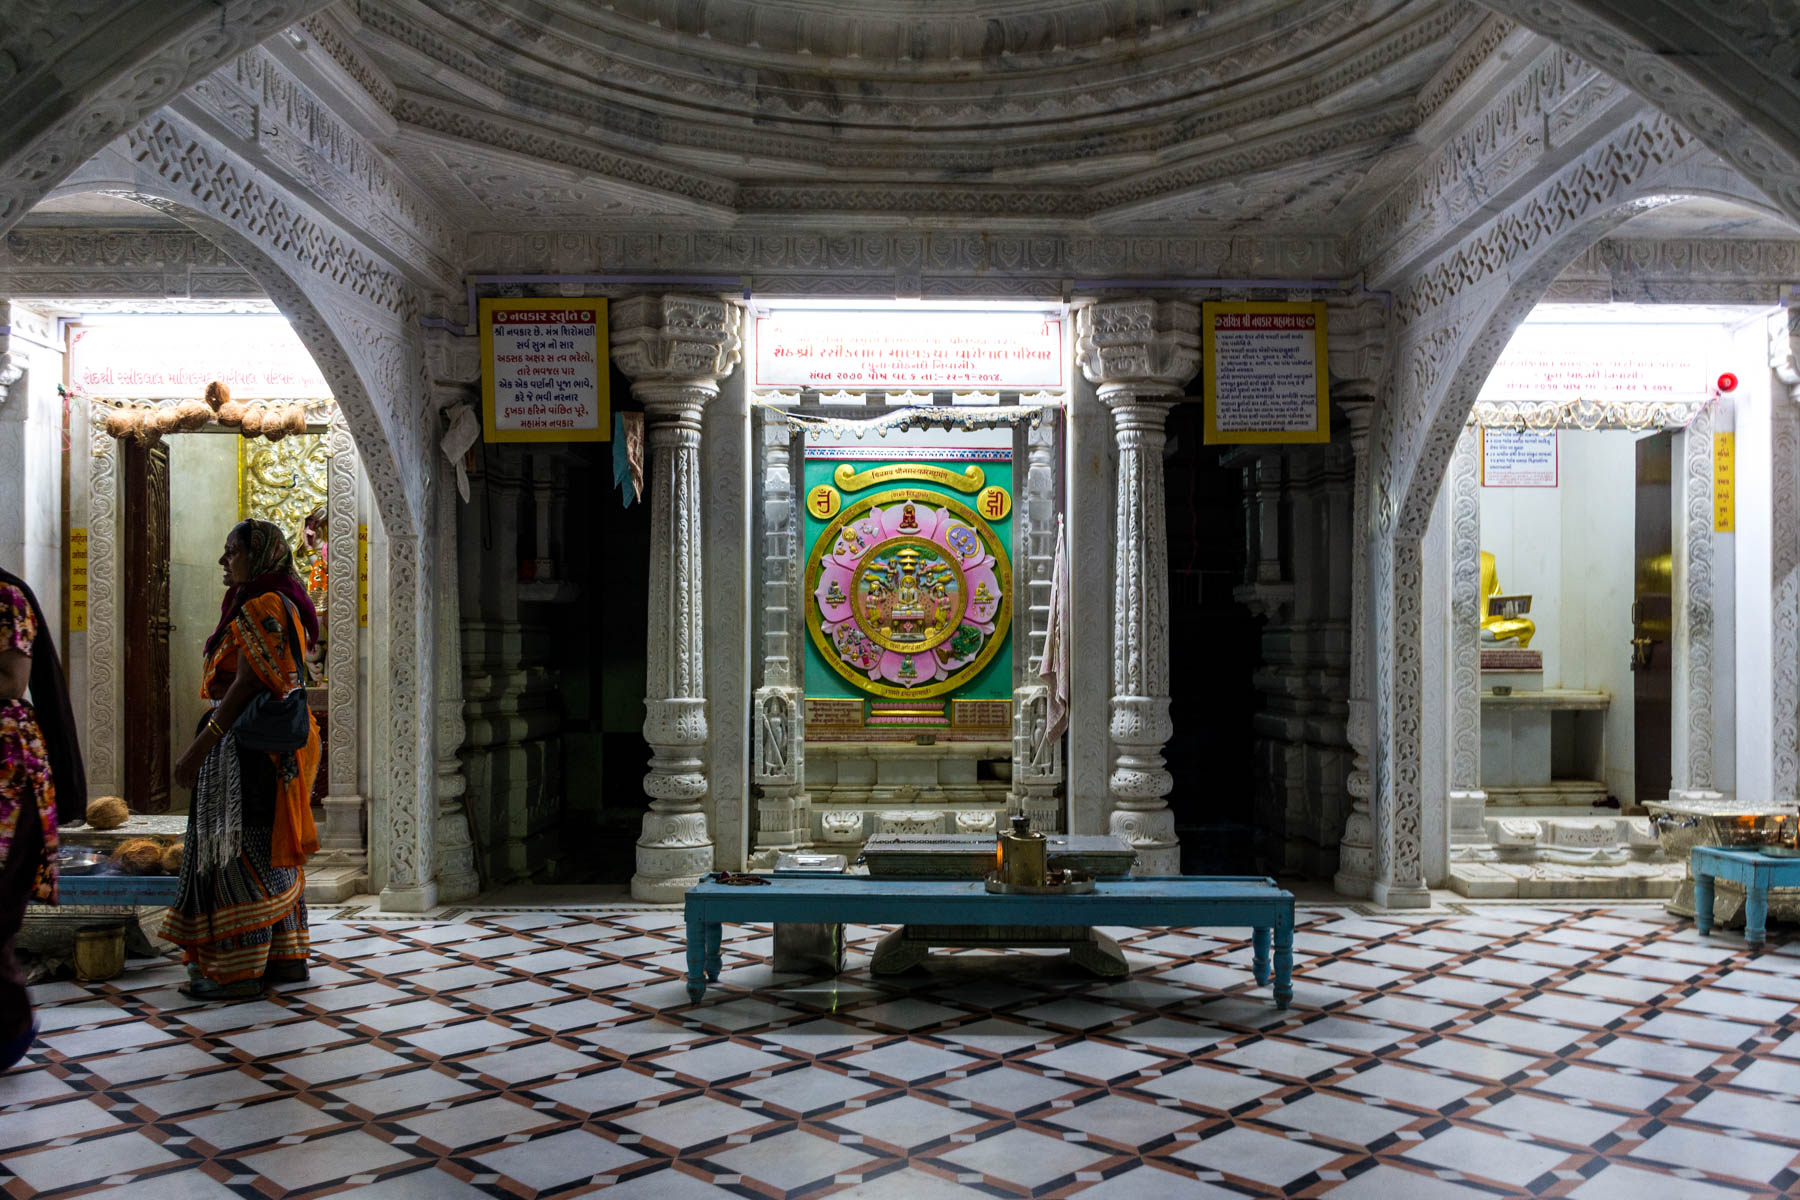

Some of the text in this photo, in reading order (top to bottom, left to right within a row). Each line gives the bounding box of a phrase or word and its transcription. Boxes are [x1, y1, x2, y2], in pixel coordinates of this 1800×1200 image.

[510, 312, 547, 321] નવકાર
[494, 325, 504, 336] શ્રી
[506, 327, 532, 336] નવકાર
[548, 339, 557, 349] નો
[559, 341, 575, 349] સાર
[517, 365, 575, 375] તારે ભવજલ પાર
[514, 391, 525, 402] કરે
[526, 391, 533, 402] જે
[549, 419, 574, 428] નવકાર
